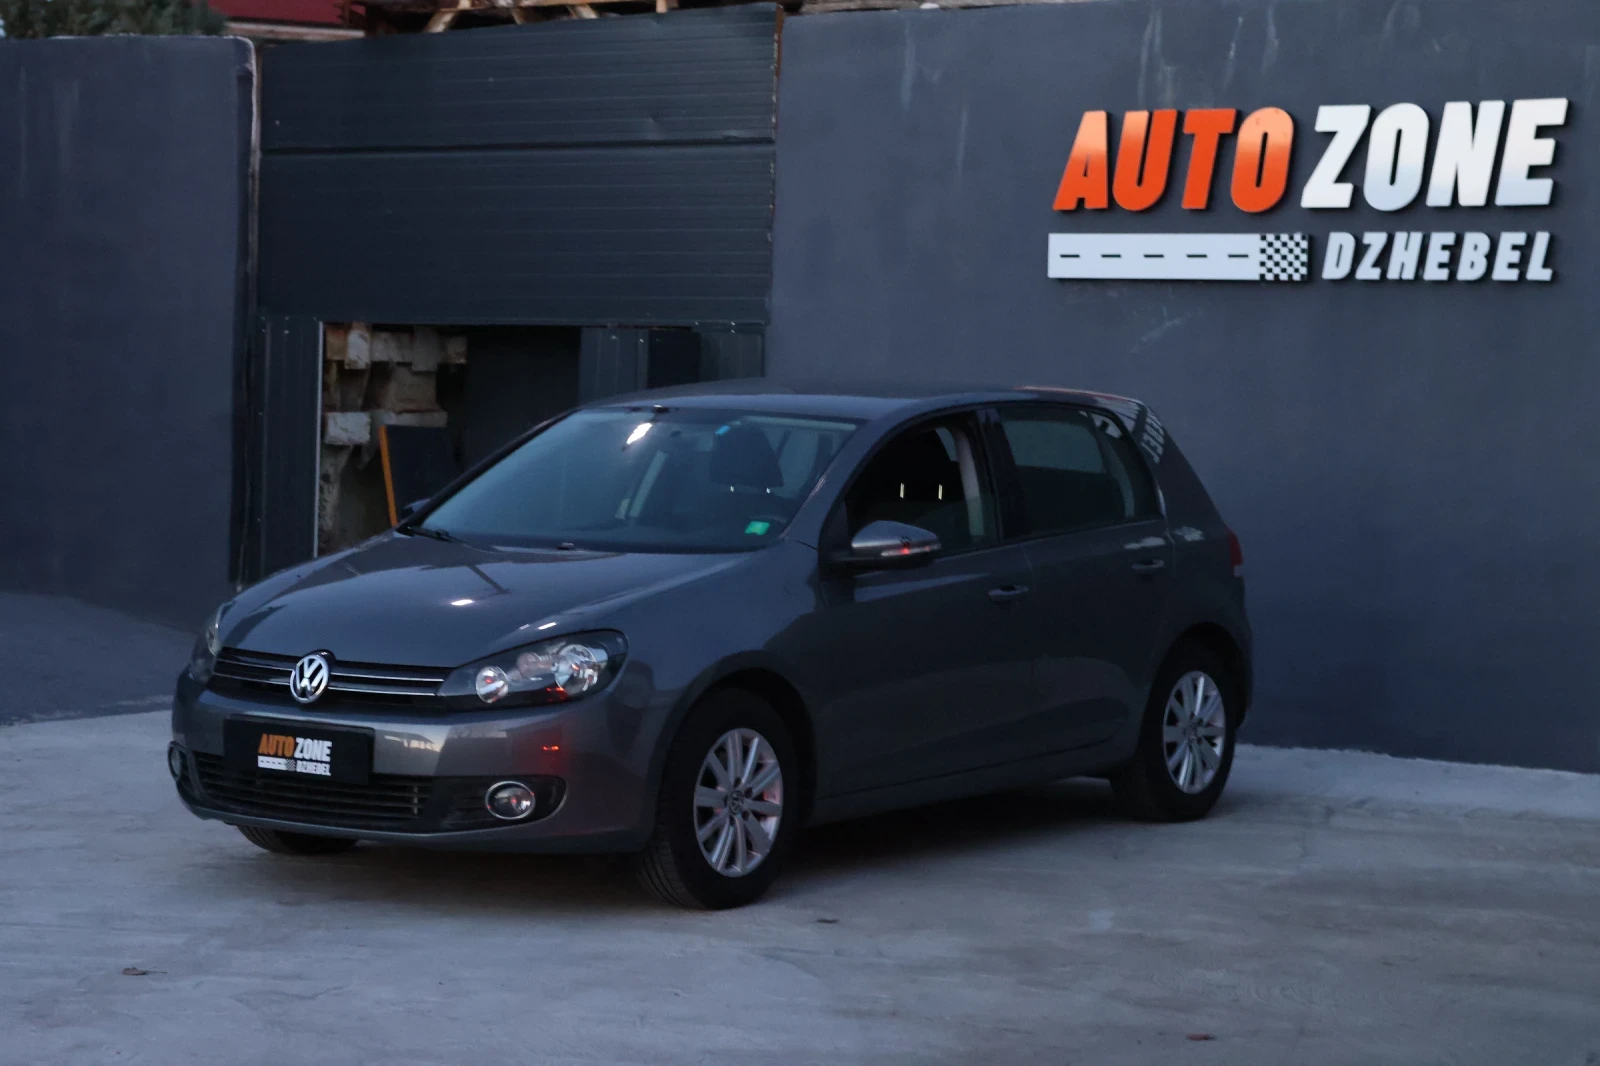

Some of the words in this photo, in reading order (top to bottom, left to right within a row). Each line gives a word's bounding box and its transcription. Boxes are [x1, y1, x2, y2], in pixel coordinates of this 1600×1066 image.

[1052, 107, 1295, 212] AUTO
[1301, 98, 1568, 211] ZONE
[1322, 231, 1553, 281] DZHEBEL
[257, 733, 295, 758] AUTO
[294, 737, 332, 762] ZONE
